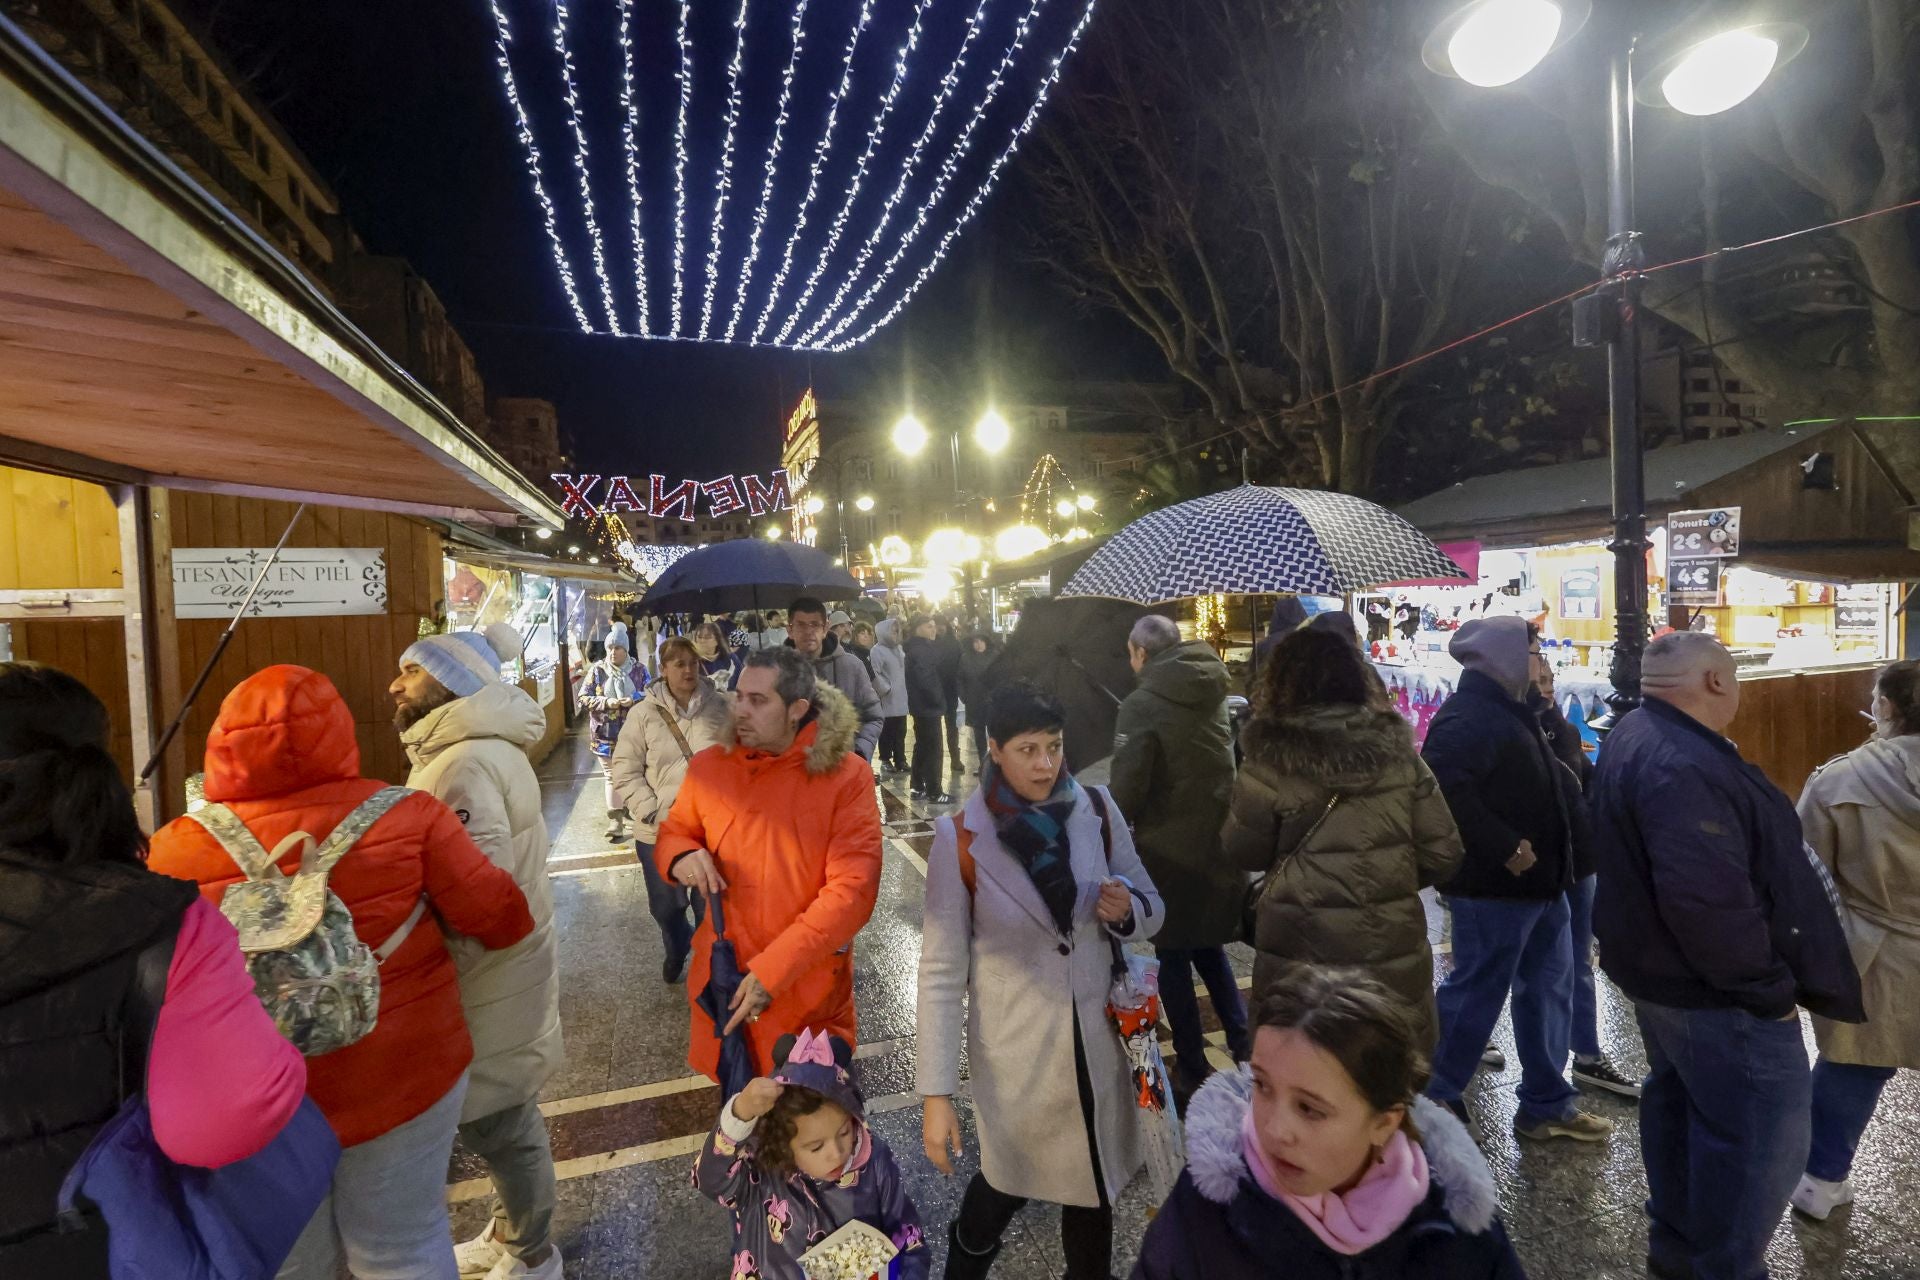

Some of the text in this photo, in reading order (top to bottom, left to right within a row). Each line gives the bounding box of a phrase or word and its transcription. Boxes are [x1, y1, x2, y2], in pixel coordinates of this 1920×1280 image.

[1671, 518, 1709, 529] Donuts
[1673, 533, 1701, 550] 2€
[280, 566, 305, 581] EN
[315, 566, 354, 581] PIEL
[1677, 567, 1709, 585] 4€
